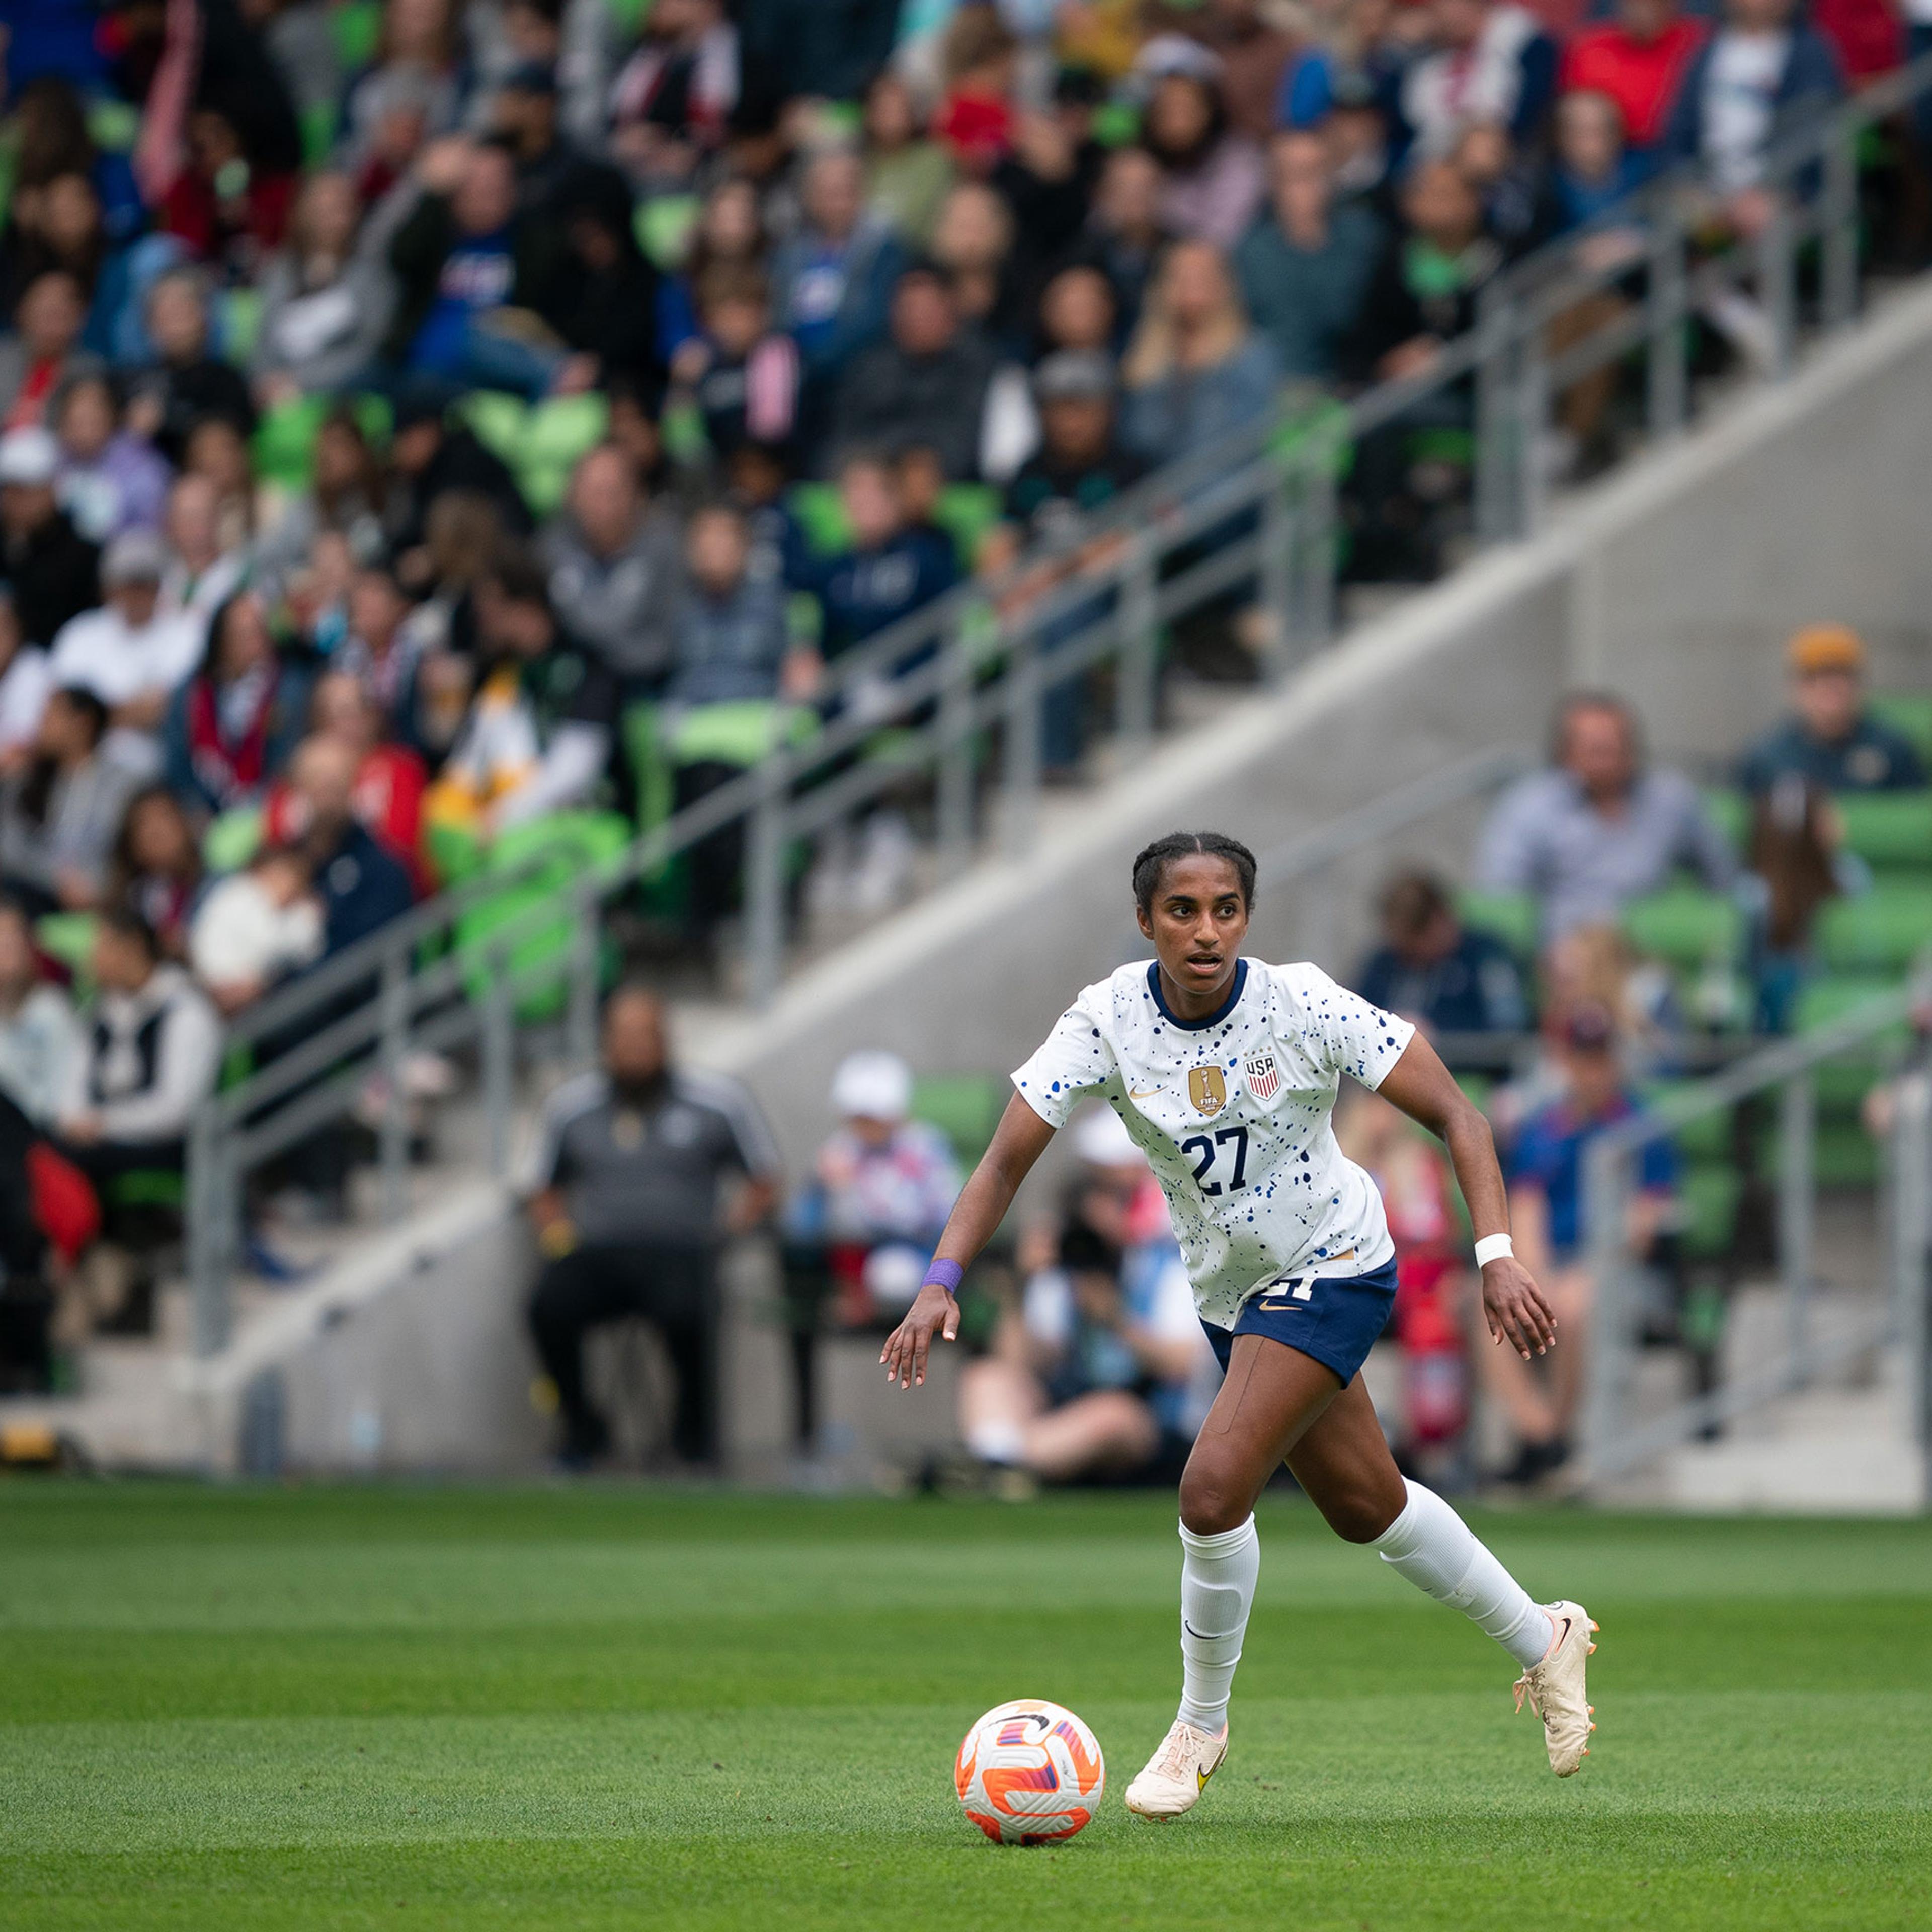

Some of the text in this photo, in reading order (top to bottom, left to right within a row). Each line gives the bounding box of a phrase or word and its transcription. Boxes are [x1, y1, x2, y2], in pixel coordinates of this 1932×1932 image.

[1246, 1057, 1274, 1076] USA
[1200, 1097, 1218, 1105] FIFA
[1181, 1126, 1249, 1196] 27
